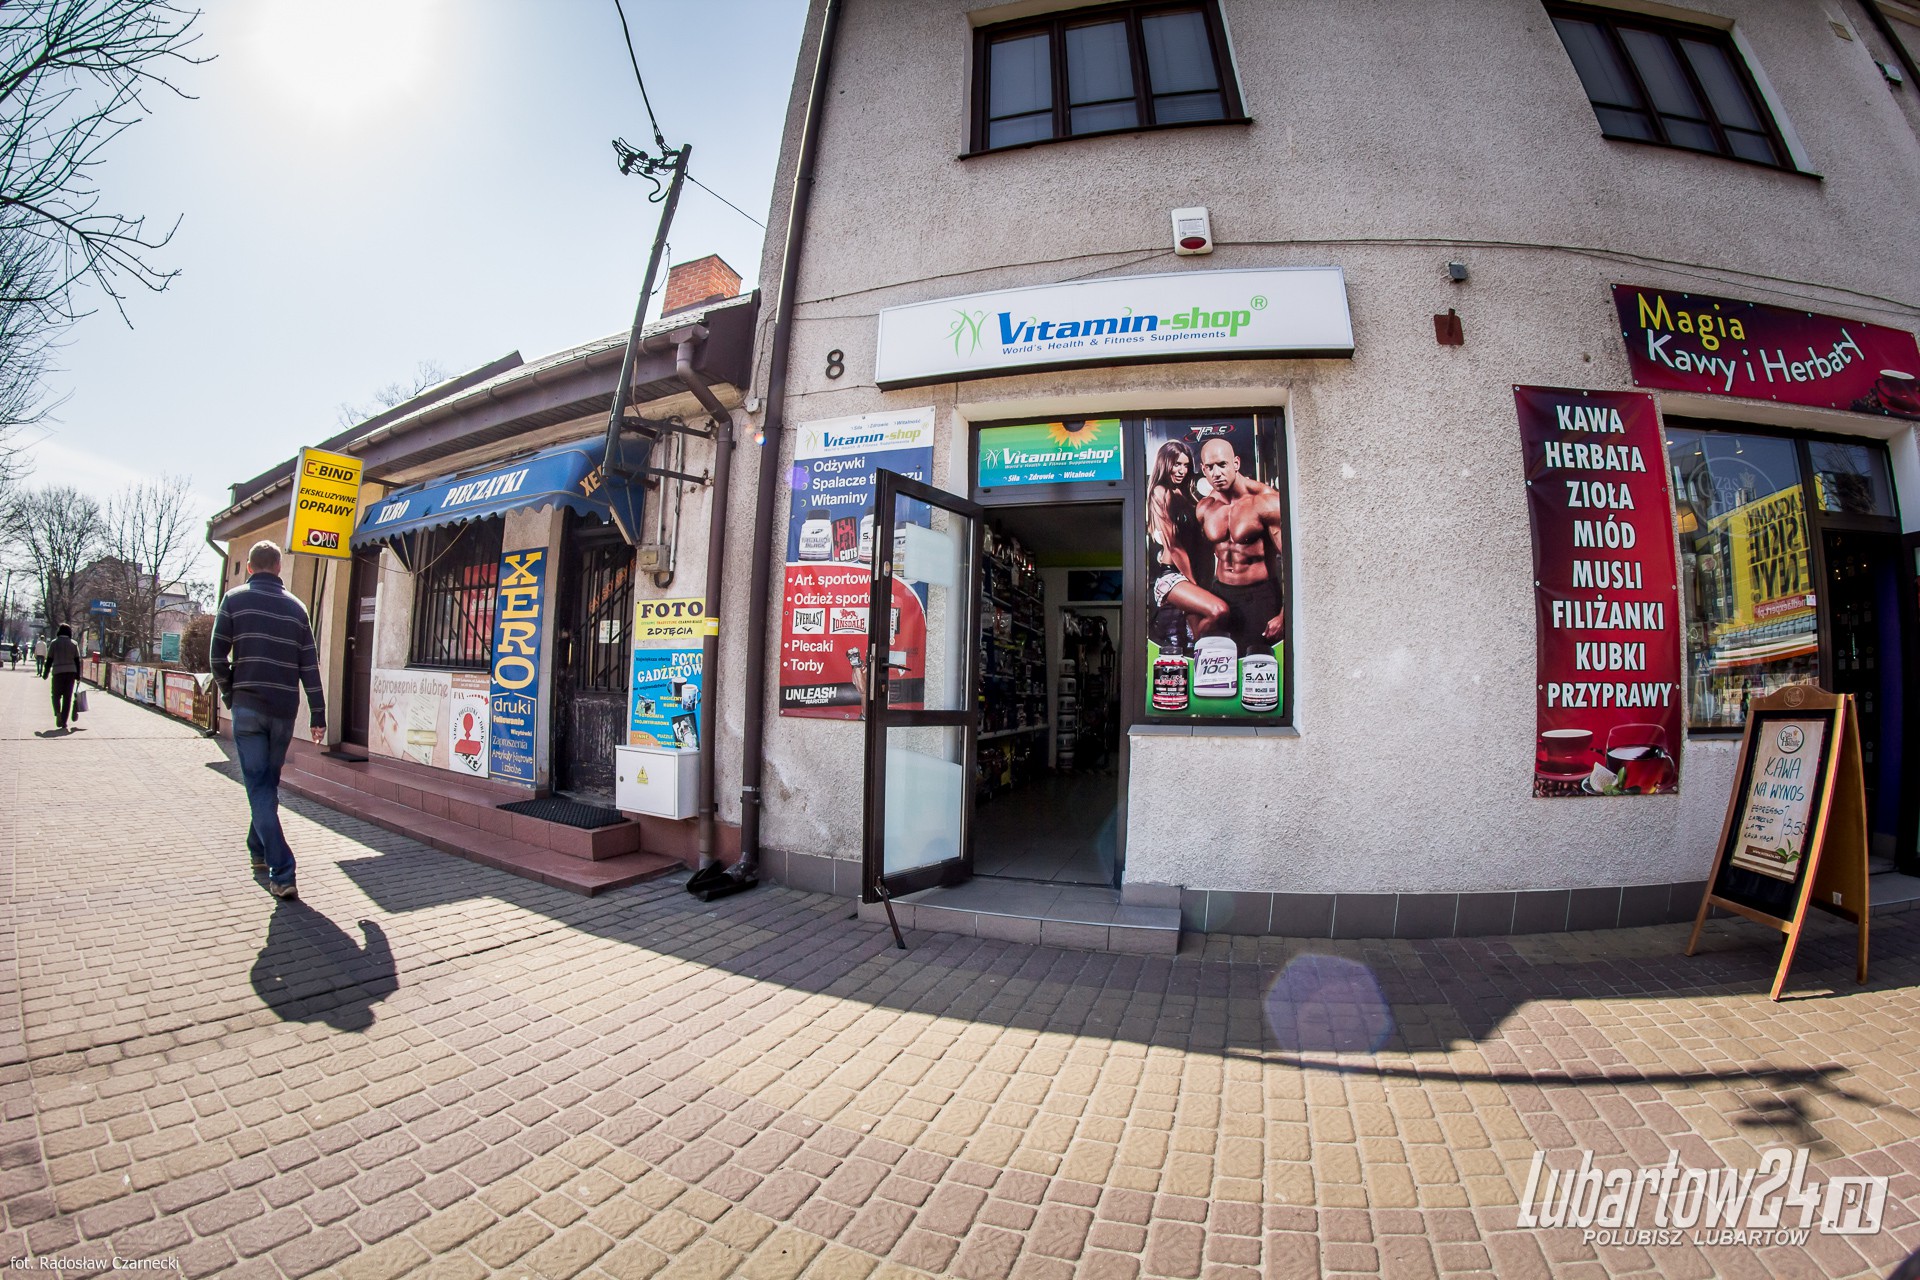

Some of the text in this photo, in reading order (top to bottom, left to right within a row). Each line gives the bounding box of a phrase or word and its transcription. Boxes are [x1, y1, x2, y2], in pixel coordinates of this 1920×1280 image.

[1637, 292, 1745, 350] Magia
[1002, 331, 1226, 355] World's Health & Fitness Supplements
[826, 349, 844, 379] 8
[1647, 328, 1864, 391] Kawy i Herbaty
[1556, 405, 1625, 434] KAWA
[1544, 441, 1646, 472] HERBATA
[813, 457, 865, 474] Odżywki
[812, 476, 866, 491] Spalacze
[1028, 471, 1055, 481] Zdrowie
[1064, 470, 1096, 479] Witalność
[300, 488, 357, 503] EKSKLUZYWNE
[375, 469, 529, 524] XERO PIECZĄTKI
[811, 492, 868, 507] Witaminy
[1566, 481, 1635, 510] ZIOŁA
[299, 500, 354, 516] OPRAWY
[1574, 514, 1636, 549] MIÓD
[839, 547, 857, 561] CUTS
[794, 574, 815, 586] Art.
[1572, 560, 1643, 589] MUSLI
[794, 592, 833, 605] Odzież
[641, 601, 703, 618] FOTO
[1552, 595, 1664, 630] FILIŻANKI
[494, 551, 542, 689] XERO
[795, 610, 824, 628] EVERLAST
[832, 617, 866, 633] LONSDALE
[647, 627, 693, 636] ZDJĘCIA
[791, 640, 834, 652] Plecaki
[671, 652, 703, 666] FOTO
[1200, 656, 1232, 665] WHEY
[1575, 642, 1646, 670] KUBKI
[637, 661, 703, 683] GADŻETÓW
[790, 659, 824, 674] Torby
[1203, 664, 1229, 675] 100
[785, 687, 837, 701] UNLEASH
[1547, 682, 1672, 708] PRZYPRAWY
[493, 698, 531, 715] druki
[492, 736, 528, 749] Zaproszenia
[1764, 756, 1801, 779] KAWA
[1753, 781, 1805, 801] NA WYNOS
